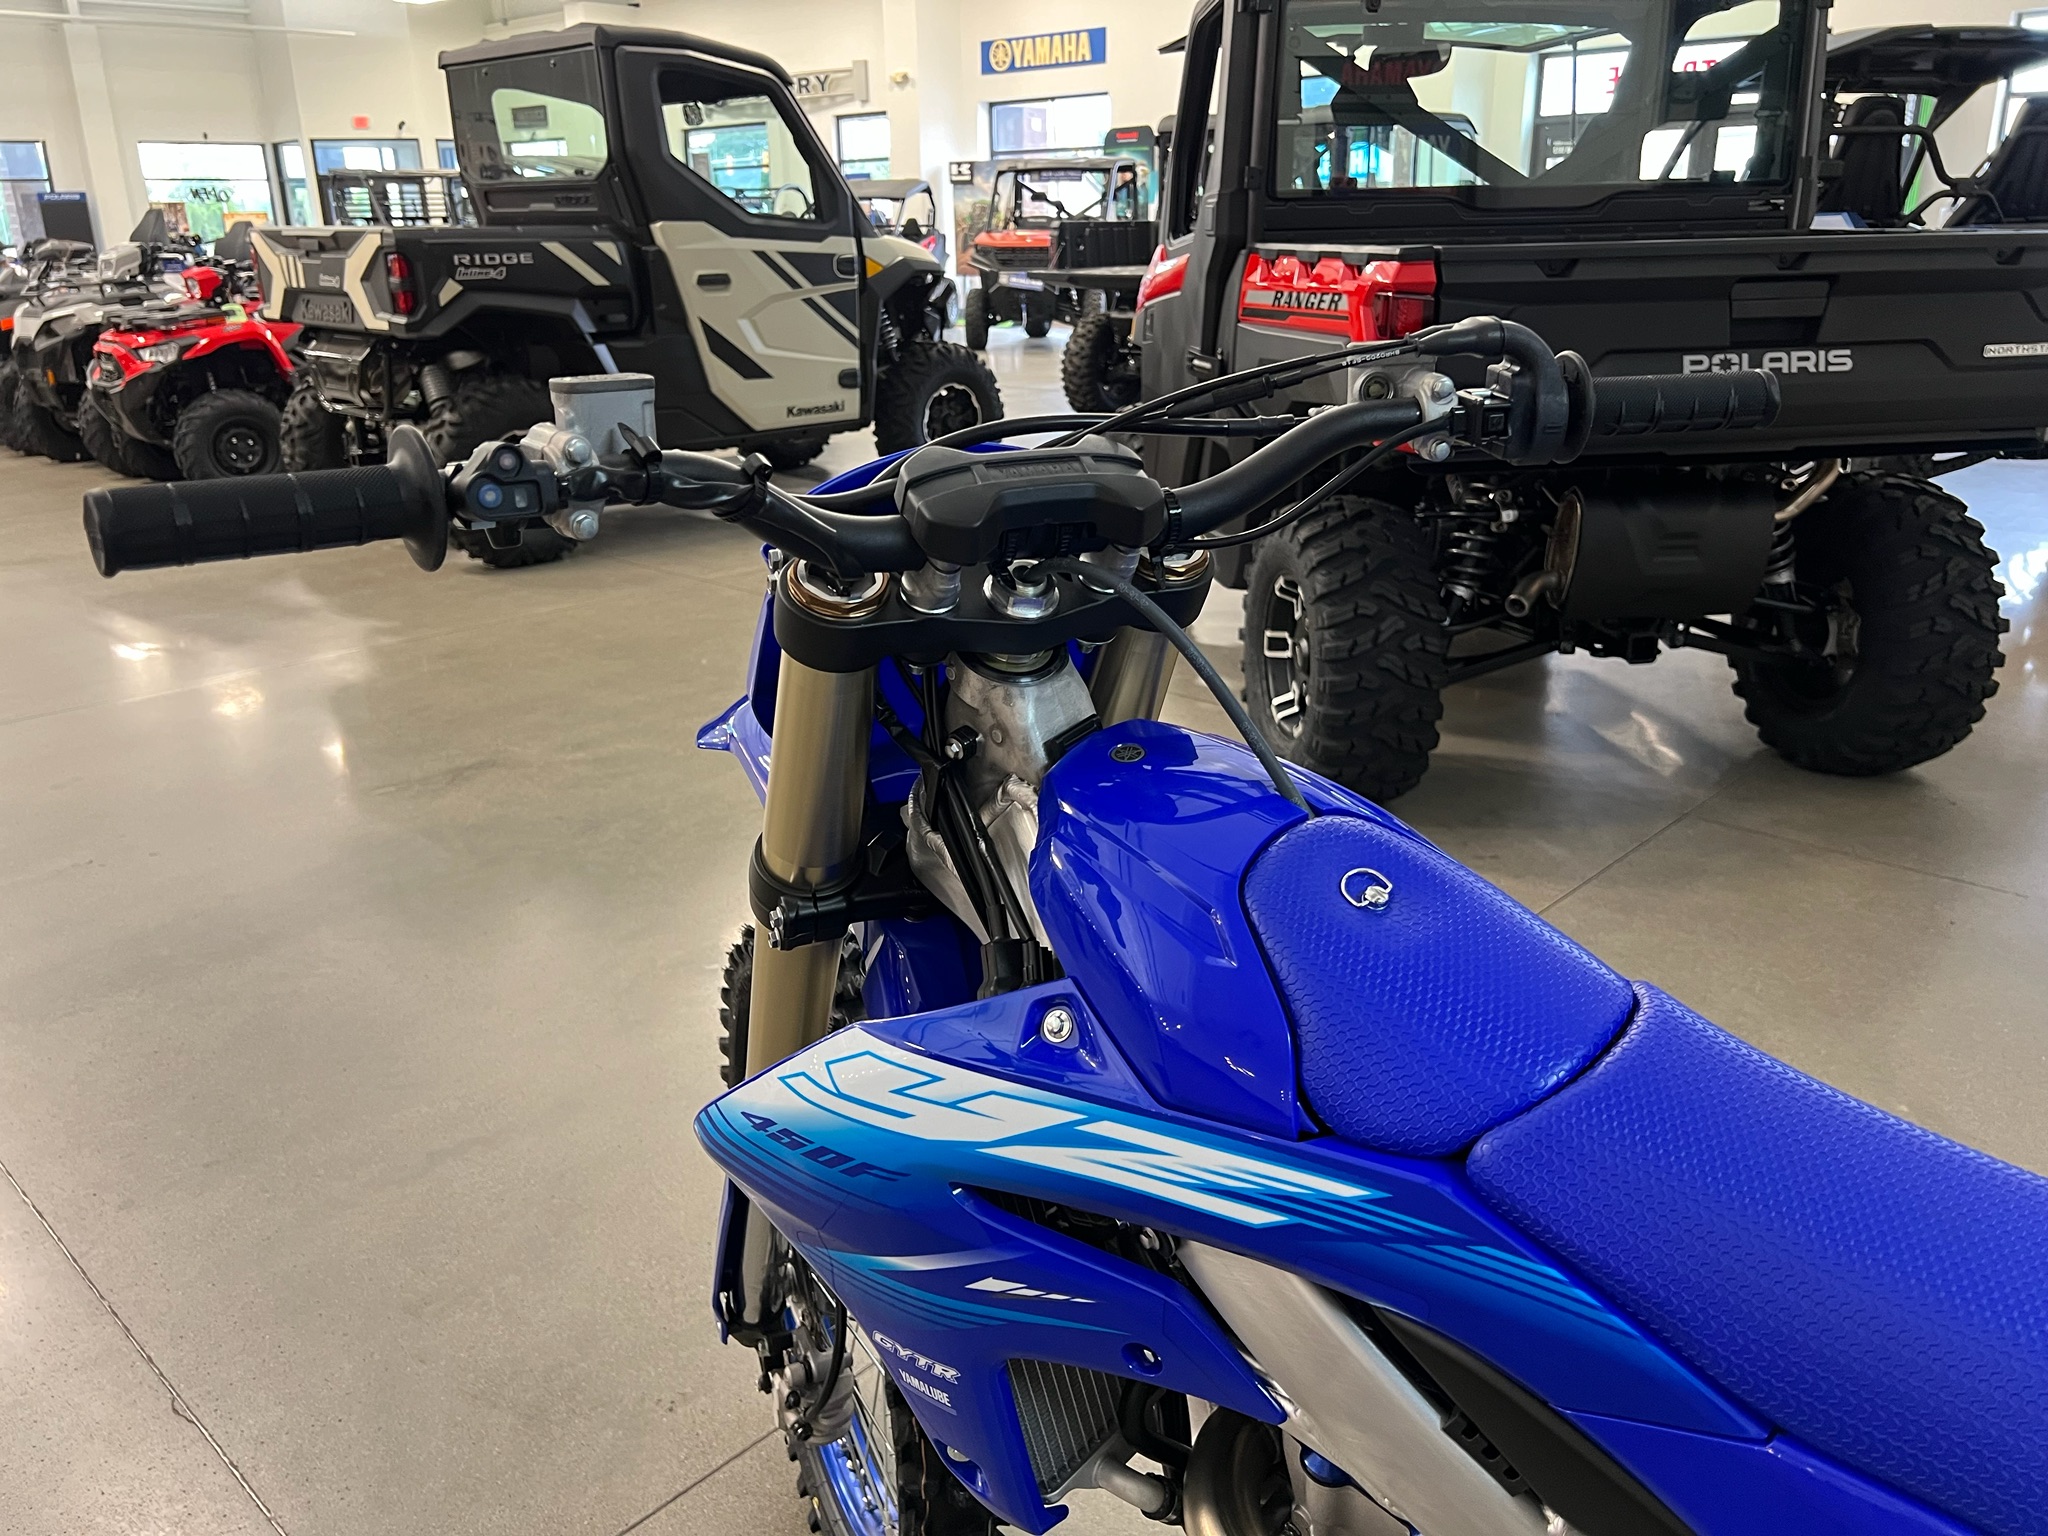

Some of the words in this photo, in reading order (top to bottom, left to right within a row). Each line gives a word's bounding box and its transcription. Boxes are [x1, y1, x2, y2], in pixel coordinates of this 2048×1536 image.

[1011, 31, 1092, 68] YAMAHA
[453, 252, 534, 266] RIDGE
[301, 298, 355, 324] Kawasaki
[1272, 290, 1342, 312] RANGER
[1682, 350, 1853, 375] POLARIS
[1987, 344, 2048, 356] NORTHST
[786, 400, 845, 418] Kawasaki
[740, 1111, 912, 1182] 450F
[872, 1330, 961, 1385] GYTR
[898, 1368, 952, 1408] YAMALUBE
